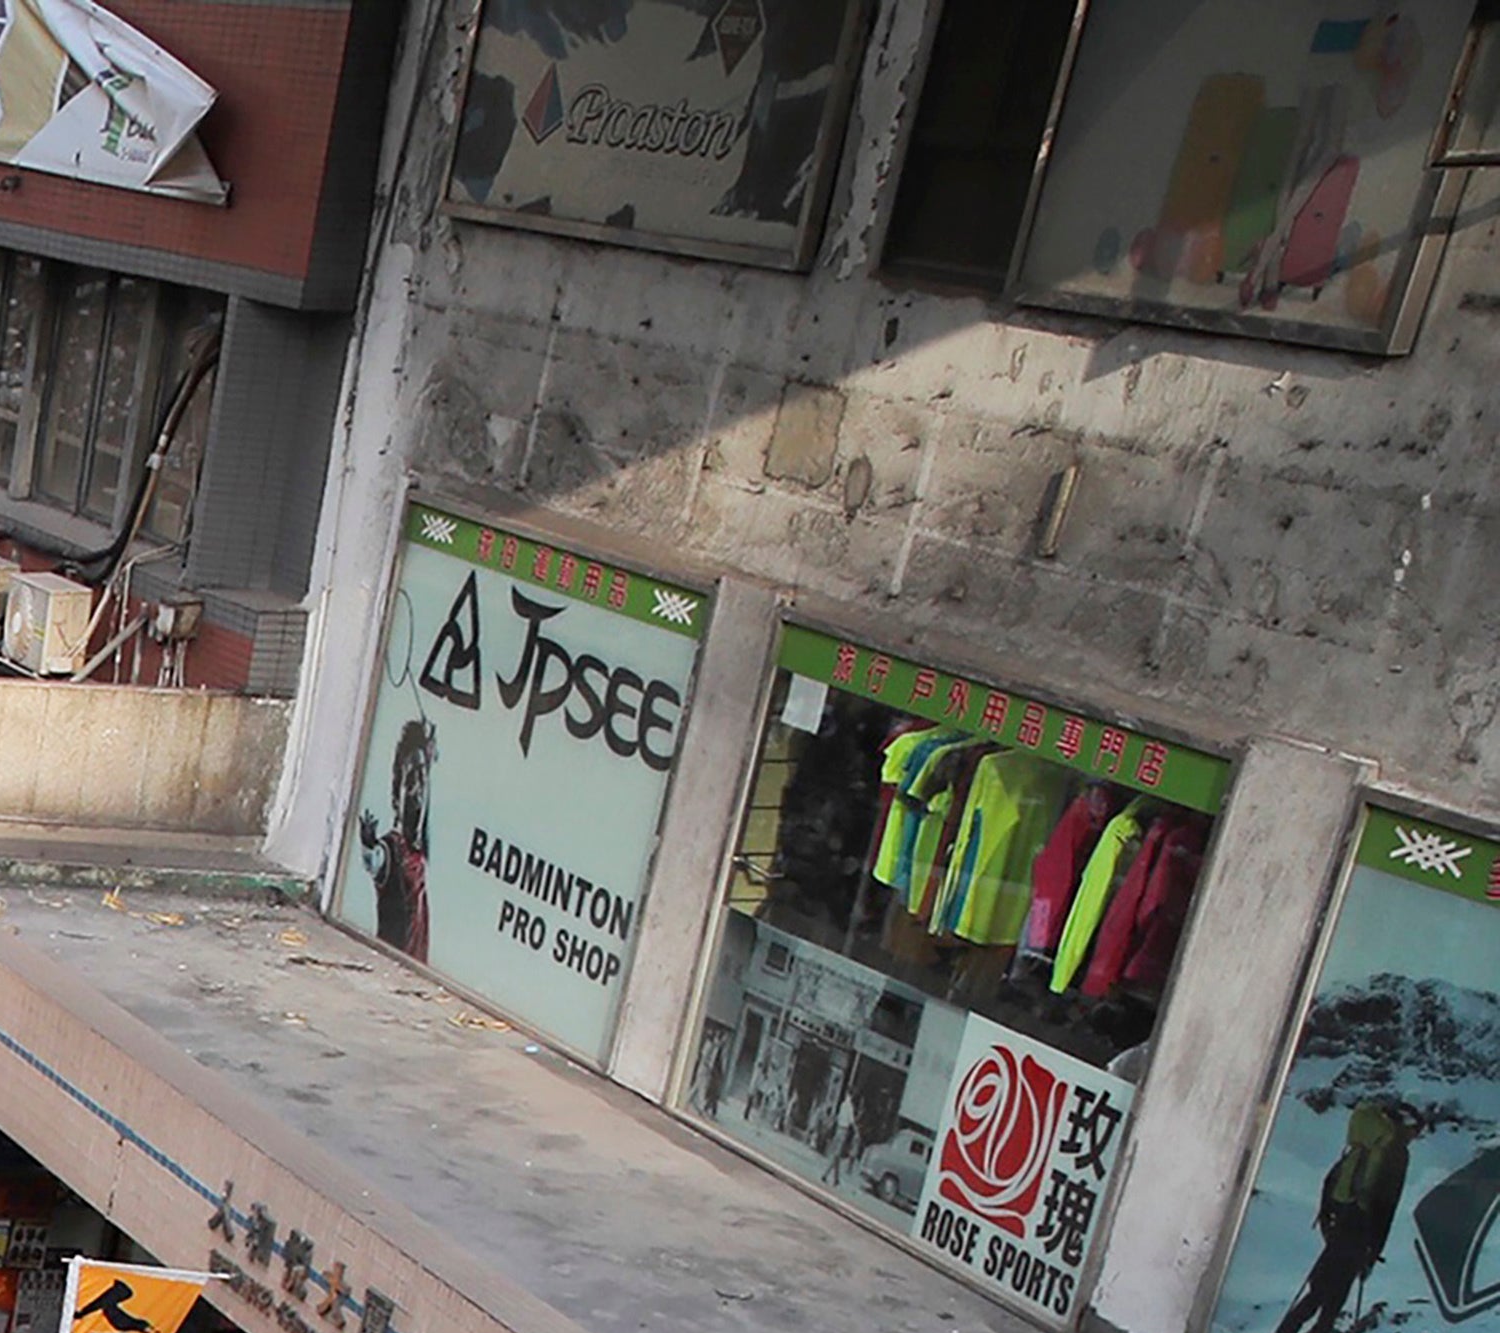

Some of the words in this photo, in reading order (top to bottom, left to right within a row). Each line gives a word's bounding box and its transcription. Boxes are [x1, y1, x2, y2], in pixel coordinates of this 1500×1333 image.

[836, 645, 888, 692] 旅行
[908, 670, 1168, 788] 戶外用品專門店
[468, 828, 633, 940] BADMINTON
[498, 901, 546, 951] PRO
[553, 930, 621, 986] SHOP
[1035, 1085, 1121, 1268] 玫瑰
[921, 1202, 979, 1263] ROSE
[983, 1237, 1076, 1316] SPORTS
